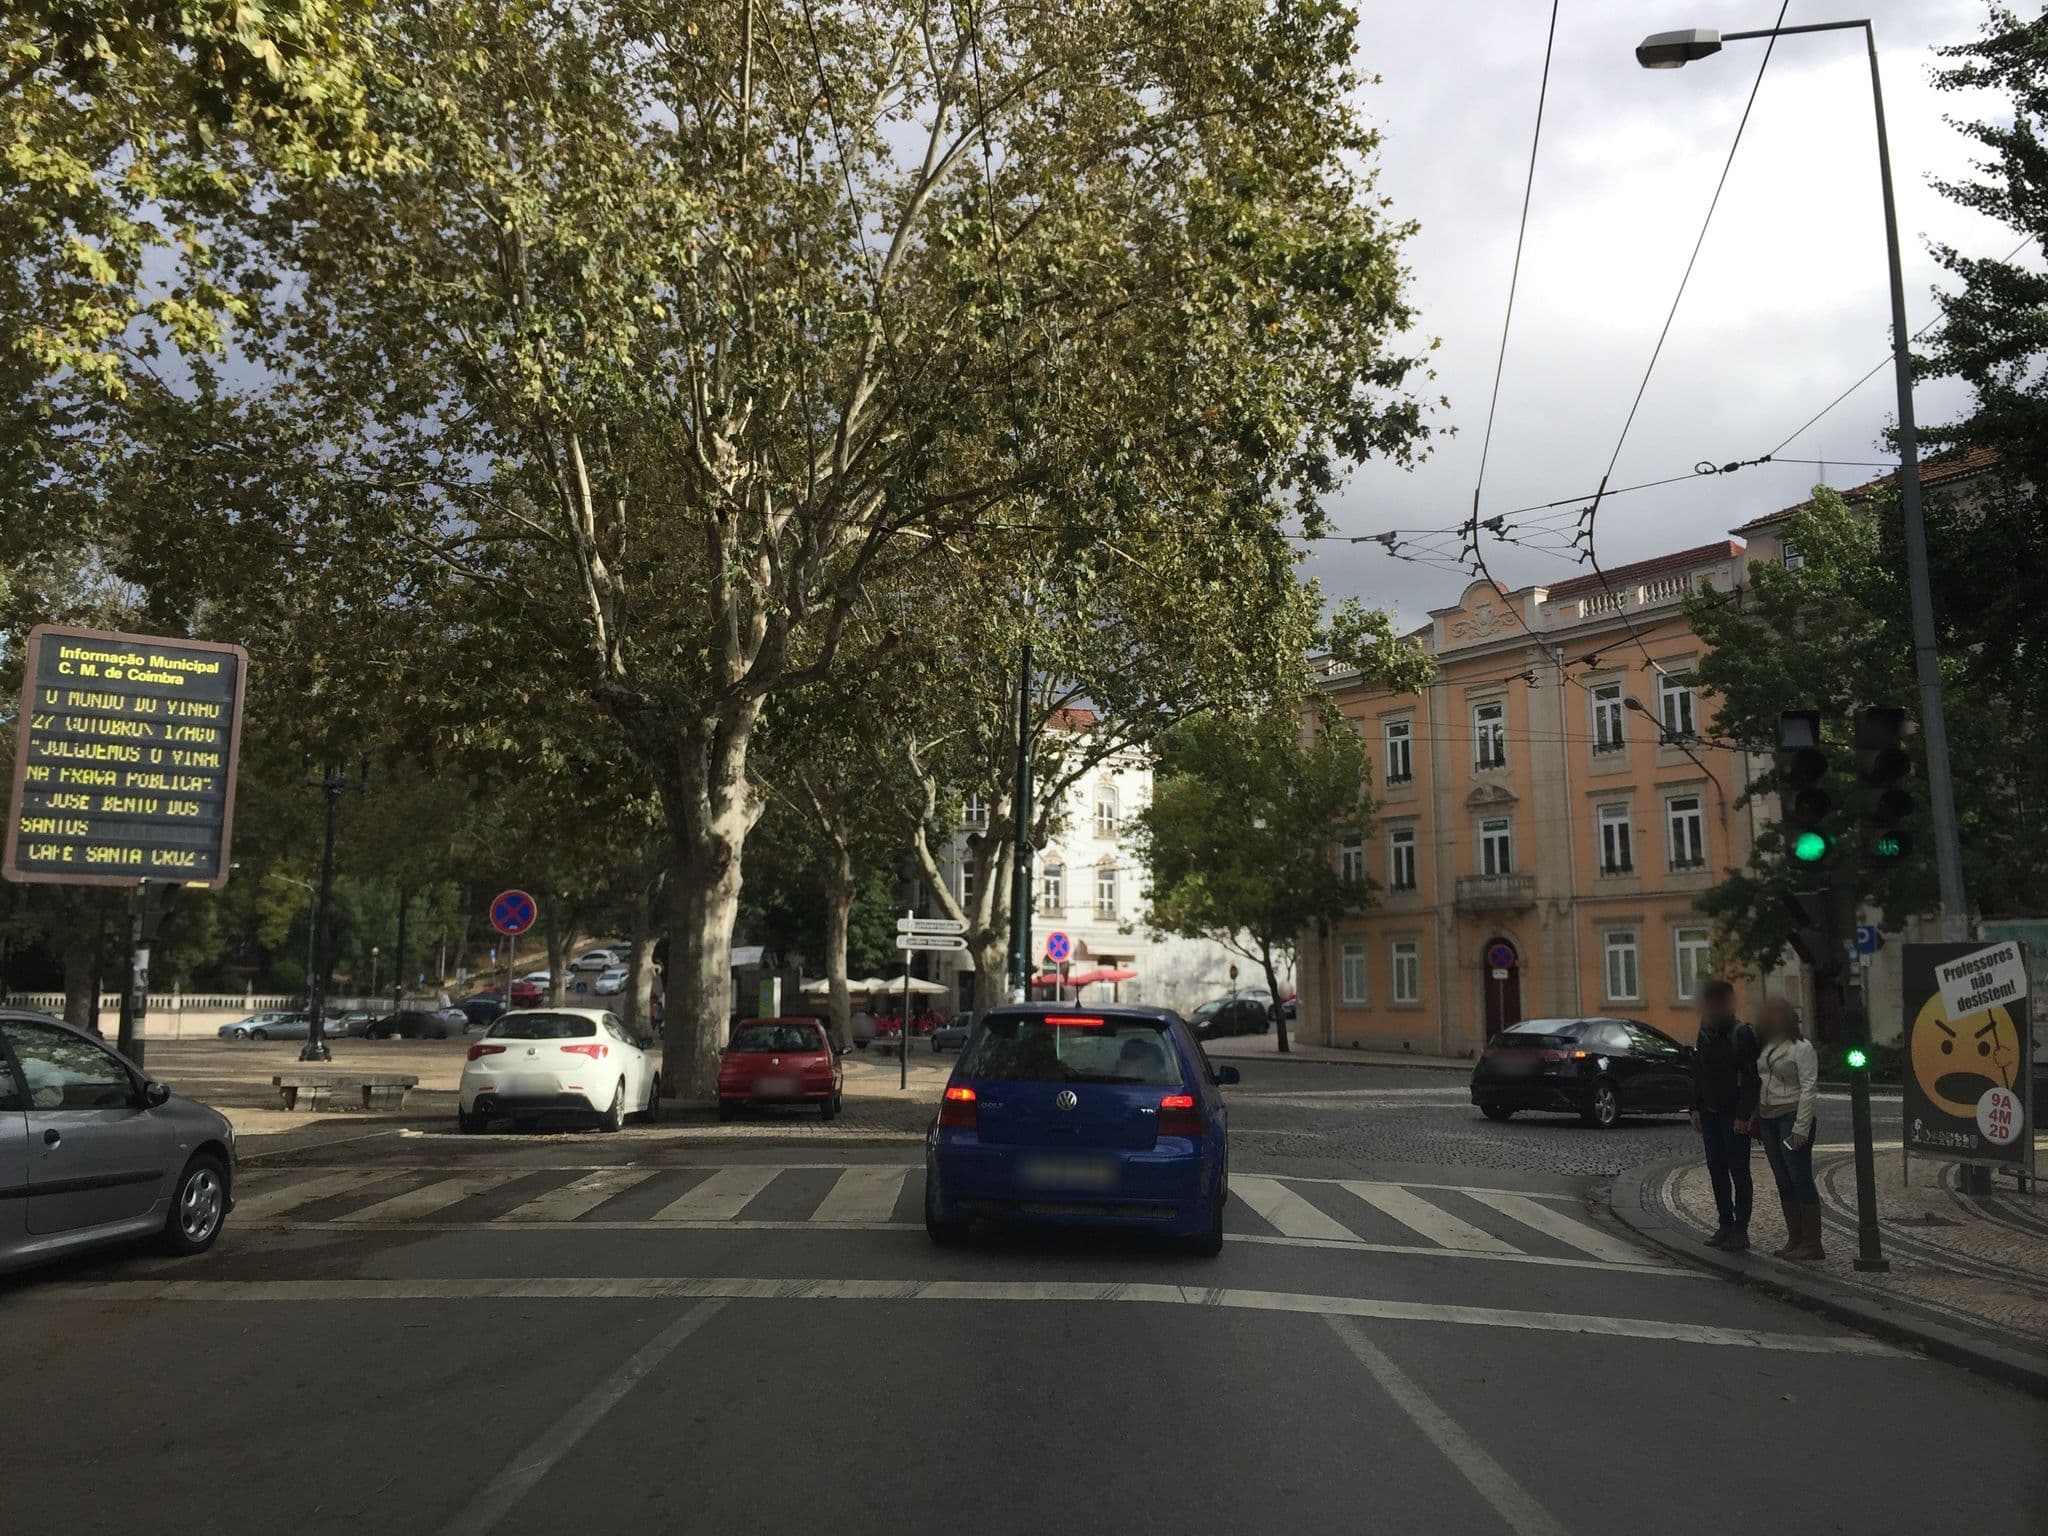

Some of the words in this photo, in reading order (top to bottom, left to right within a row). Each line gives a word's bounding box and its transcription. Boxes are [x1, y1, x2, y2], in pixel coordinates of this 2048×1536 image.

[60, 646, 145, 666] Informação
[149, 655, 220, 674] Municipal
[58, 661, 75, 674] C.
[80, 663, 99, 677] M.
[104, 667, 122, 679] de
[127, 669, 184, 685] Coimbra
[1943, 947, 2014, 983] Professores
[1969, 971, 1994, 991] não
[1956, 980, 2016, 1013] desistem!
[1991, 1092, 2012, 1110] 9A
[1989, 1108, 2011, 1125] 4M
[1989, 1123, 2009, 1140] 2D
